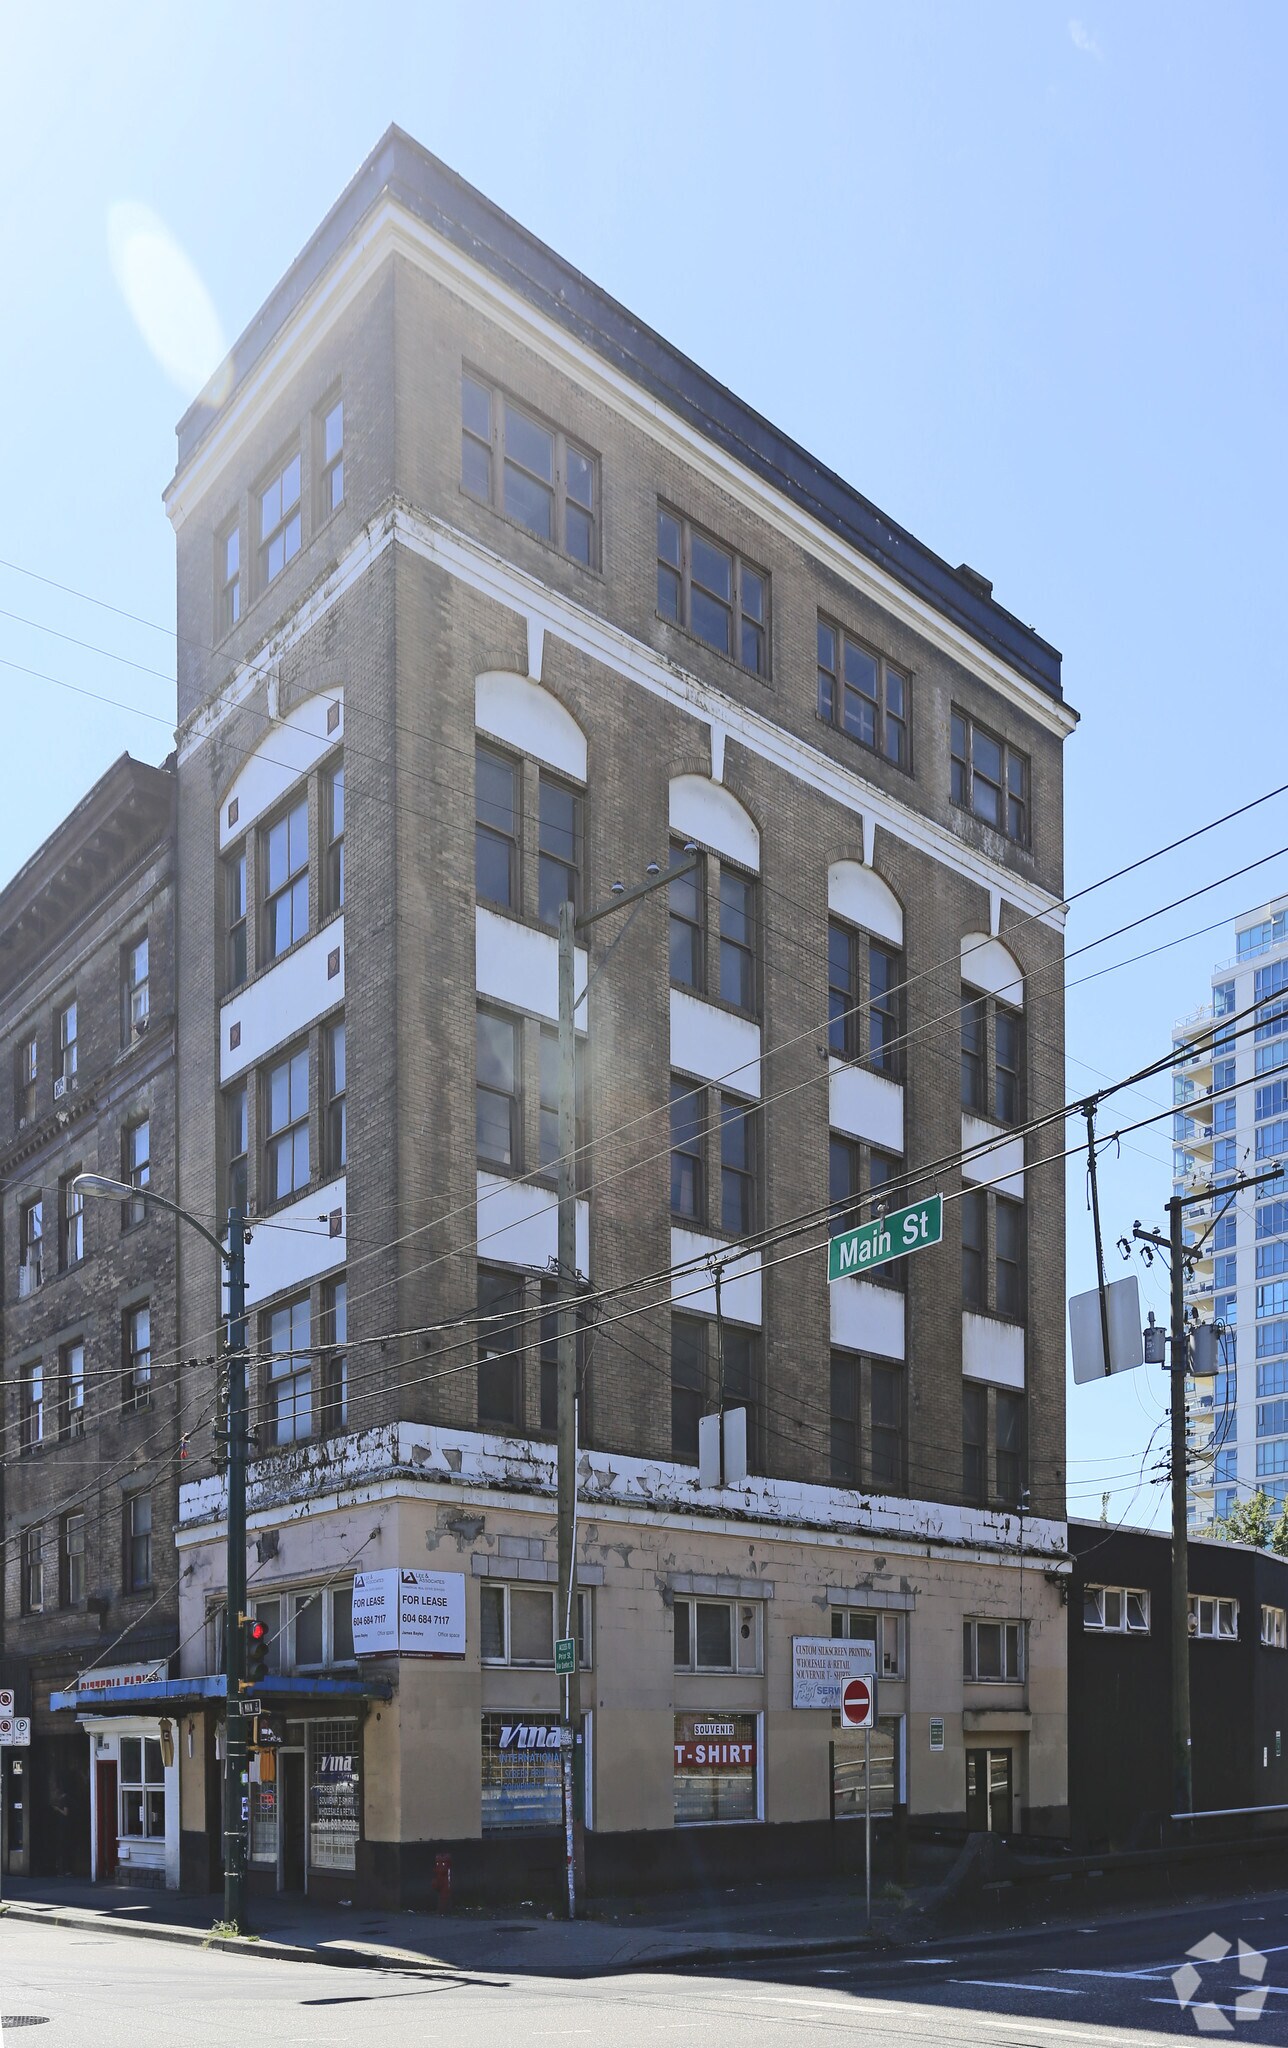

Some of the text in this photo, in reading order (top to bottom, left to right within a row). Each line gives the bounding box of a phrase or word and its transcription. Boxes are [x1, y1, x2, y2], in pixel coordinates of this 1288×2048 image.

[840, 1210, 928, 1270] Main St
[354, 1596, 385, 1608] FOR LEASE
[402, 1595, 448, 1607] FOR LEASE
[353, 1614, 386, 1626] 604 684 7117
[402, 1613, 450, 1625] 604 684 7117
[796, 1645, 872, 1658] CUSTOM SILKSCREEN PRINTING
[796, 1658, 850, 1670] WHOLESALE & RETAIL
[817, 1686, 840, 1694] SERV
[695, 1725, 734, 1734] SOUVENIR
[674, 1744, 752, 1764] T-SHIRT
